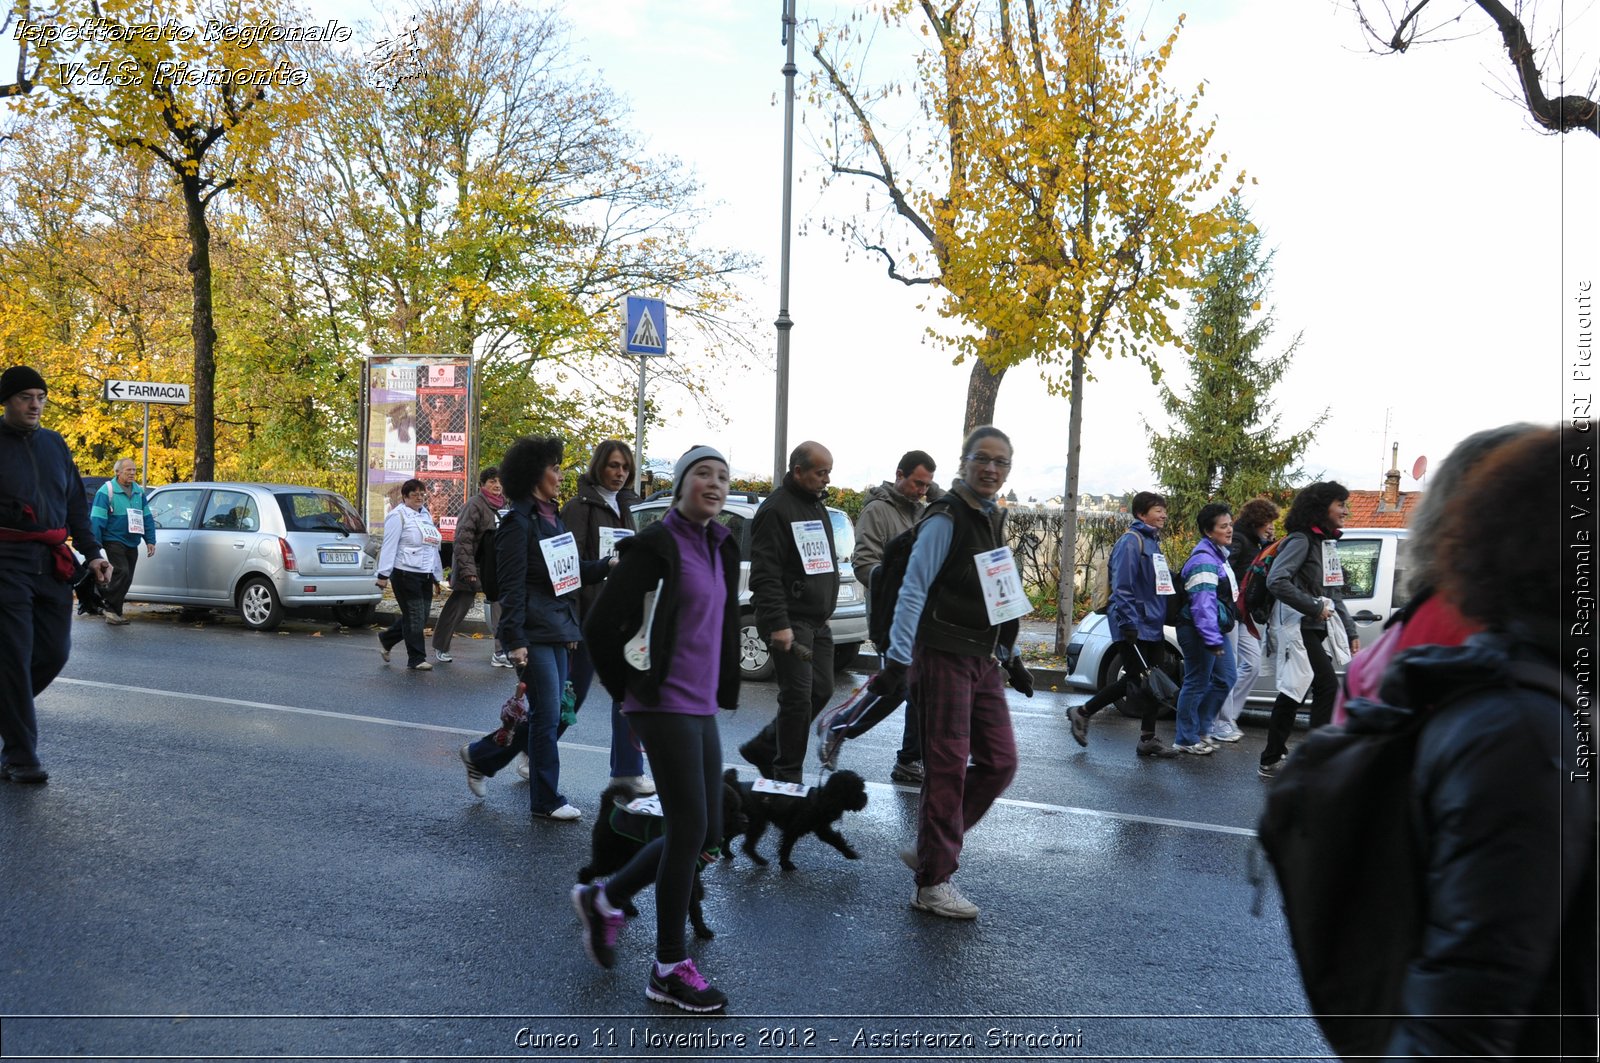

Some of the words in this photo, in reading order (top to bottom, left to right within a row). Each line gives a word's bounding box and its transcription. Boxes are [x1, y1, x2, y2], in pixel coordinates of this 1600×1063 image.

[128, 385, 186, 399] FARMACIA
[802, 541, 825, 557] 10350
[553, 556, 574, 576] 10347
